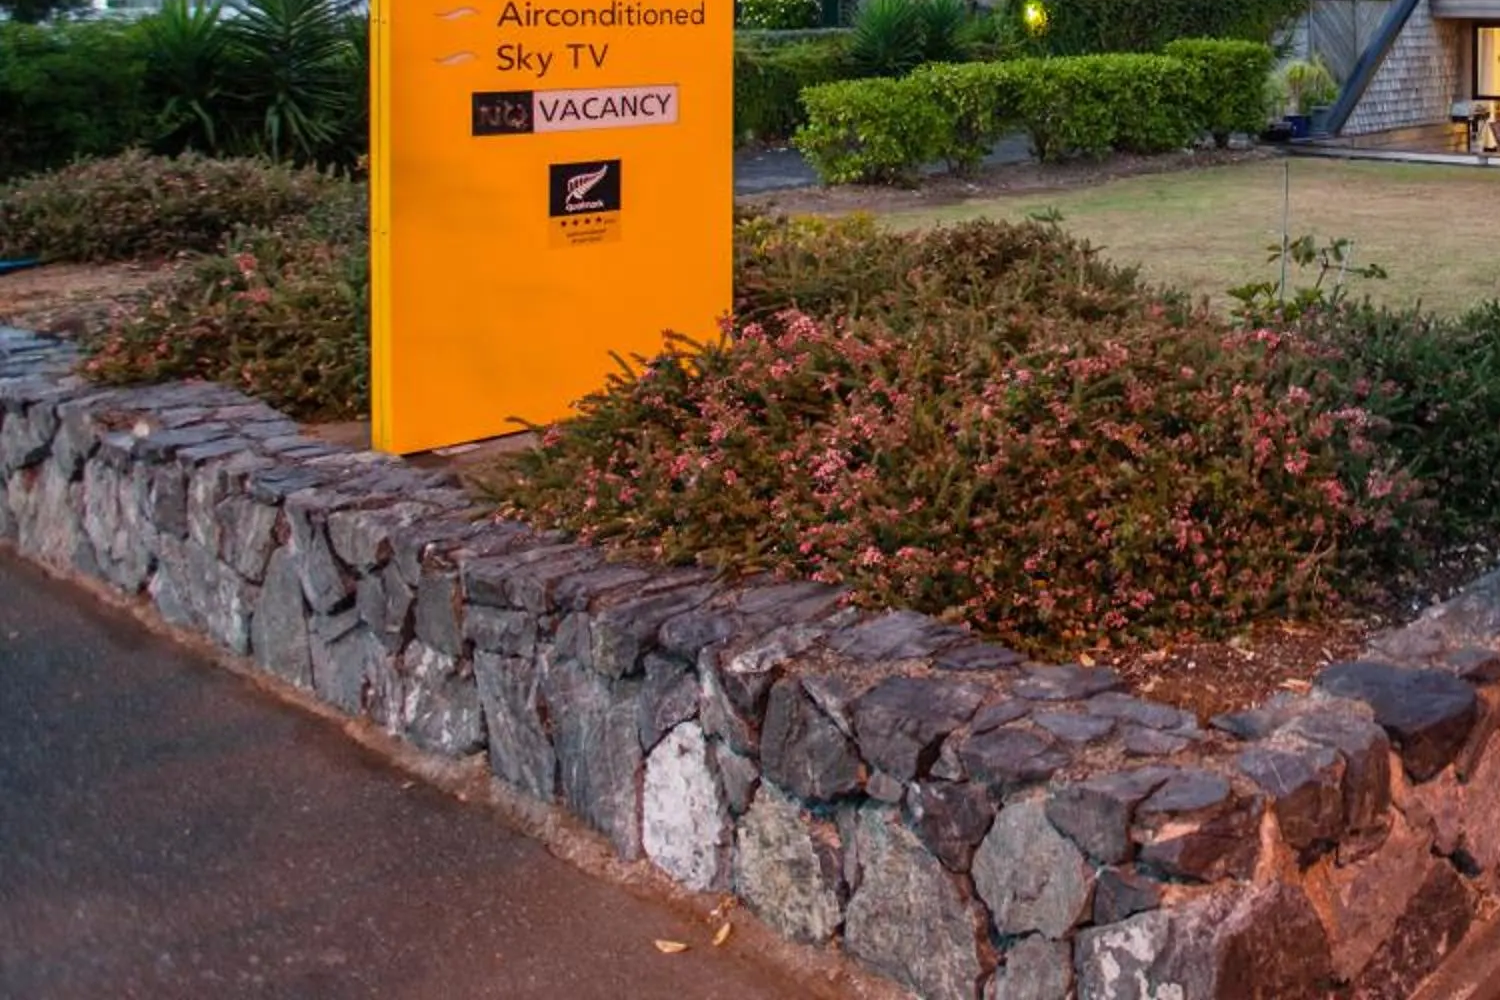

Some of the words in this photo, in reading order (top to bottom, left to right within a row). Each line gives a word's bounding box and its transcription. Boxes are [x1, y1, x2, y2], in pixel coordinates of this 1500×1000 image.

[497, 0, 705, 27] Airconditioned
[496, 44, 553, 77] Sky
[566, 44, 609, 69] TV
[539, 94, 671, 122] VACANCY
